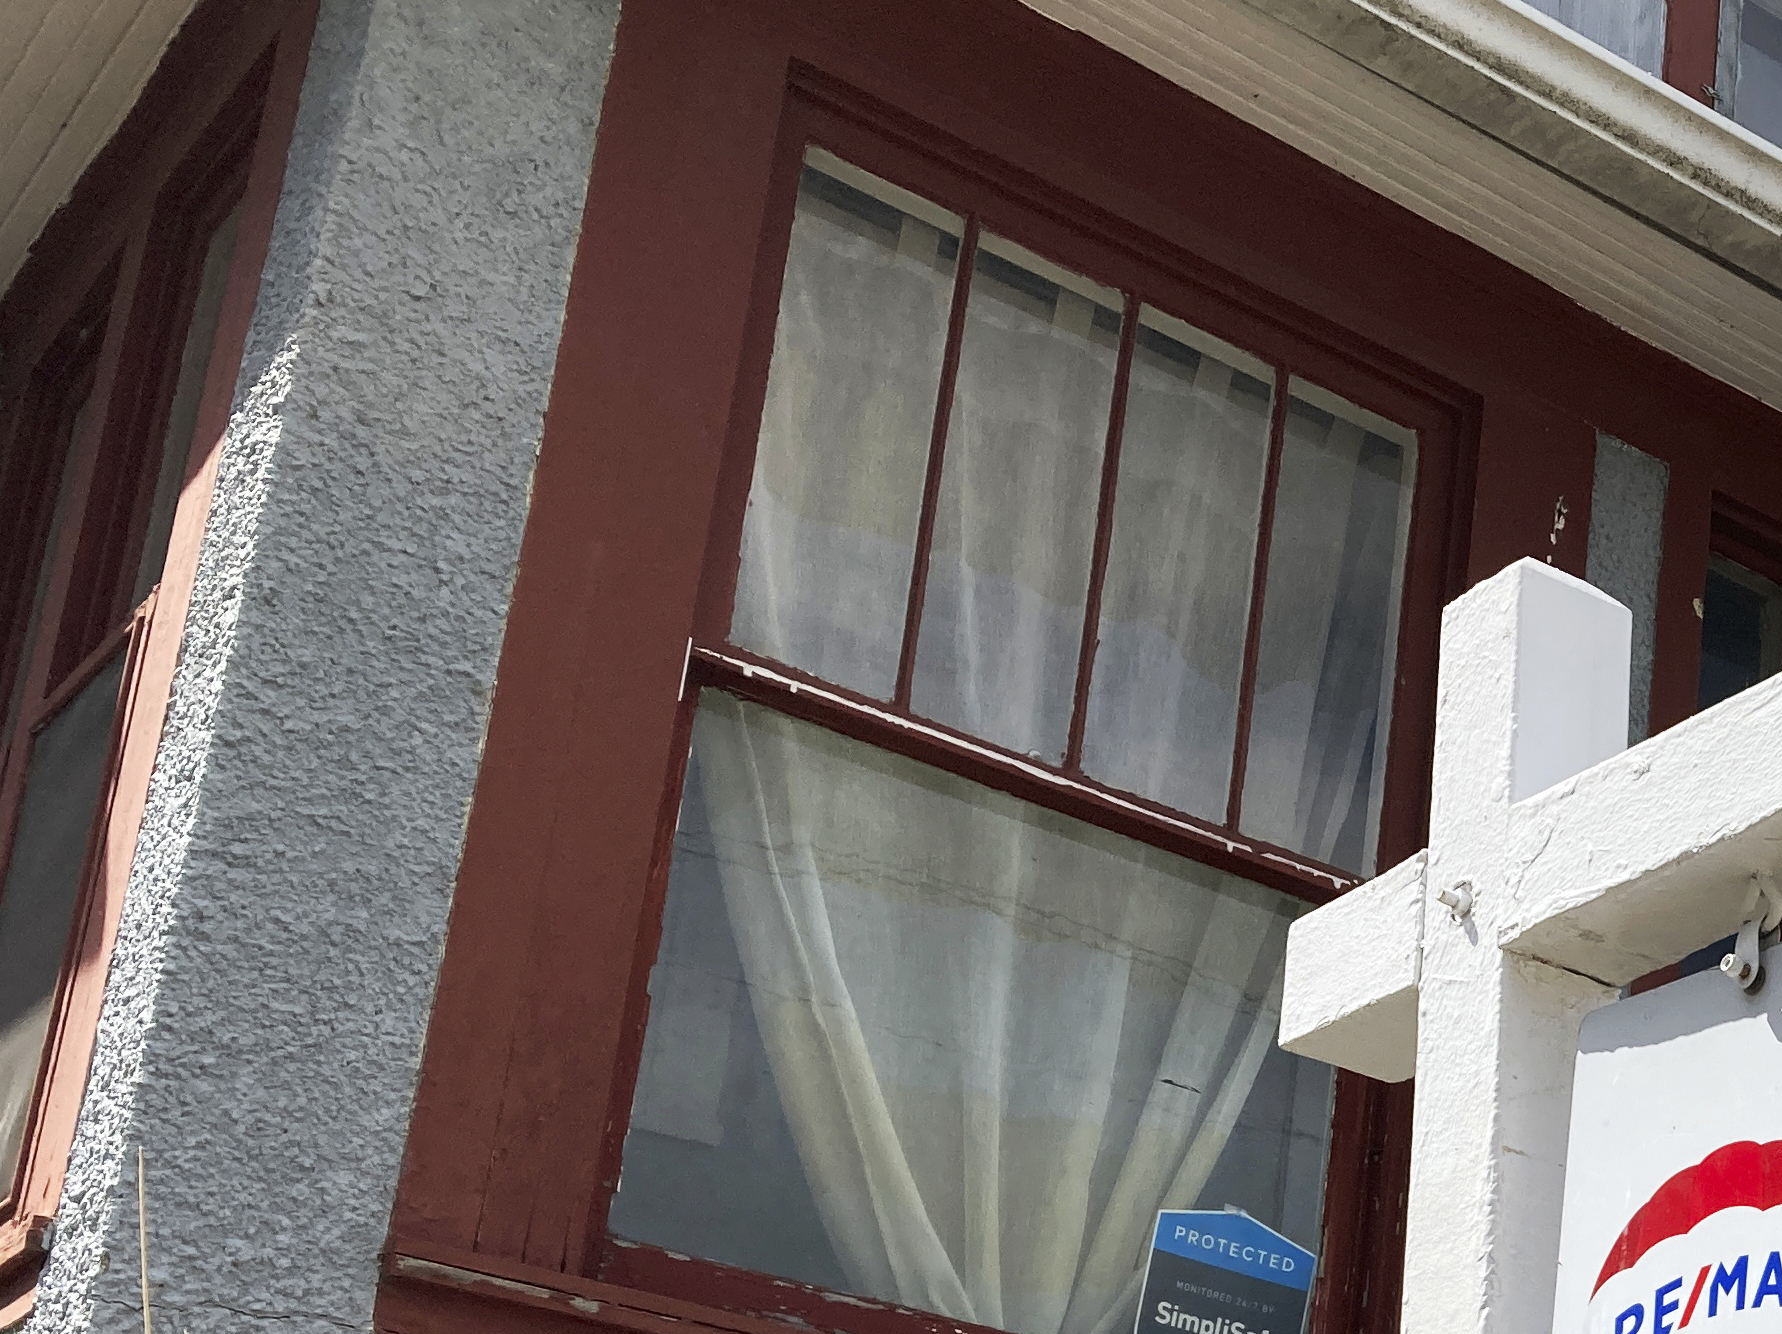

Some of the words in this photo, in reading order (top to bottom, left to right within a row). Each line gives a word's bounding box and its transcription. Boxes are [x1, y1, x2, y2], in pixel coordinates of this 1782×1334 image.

[1174, 1225, 1296, 1272] PROTECTED
[1176, 1280, 1233, 1303] MONITORED
[1262, 1305, 1275, 1315] BY
